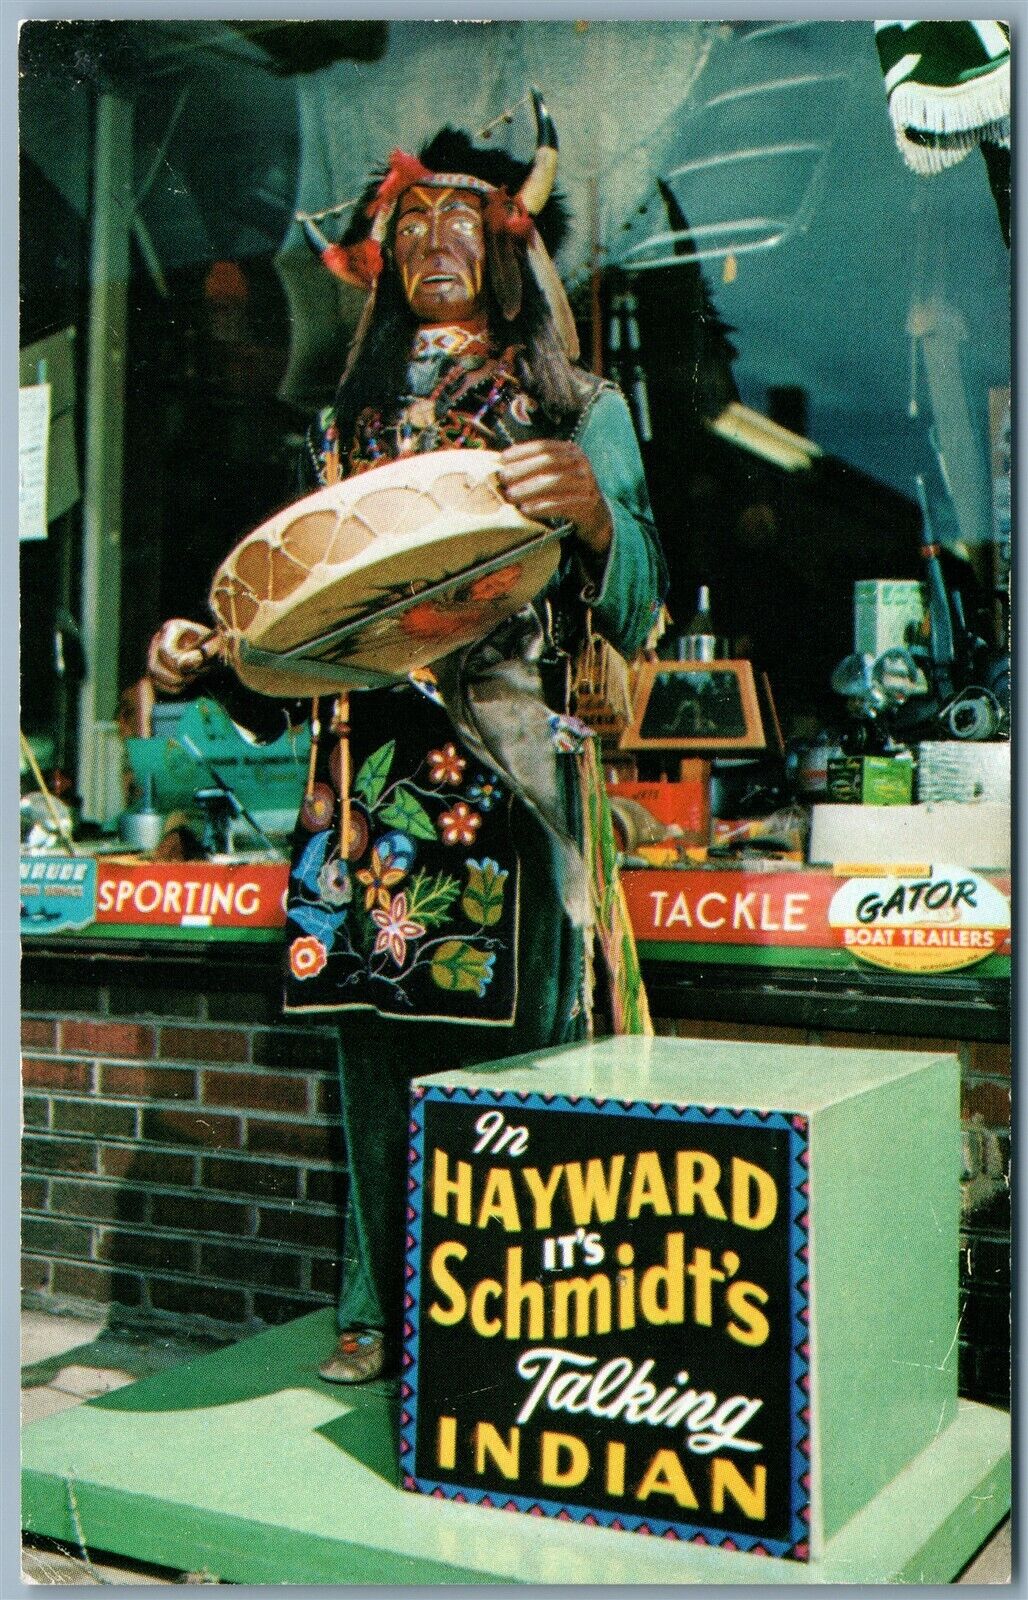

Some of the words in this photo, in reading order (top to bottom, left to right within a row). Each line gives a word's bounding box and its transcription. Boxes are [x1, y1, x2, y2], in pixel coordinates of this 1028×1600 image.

[99, 880, 260, 915] SPORTING
[651, 891, 810, 932] TACKLE
[856, 878, 978, 924] GATOR
[844, 928, 895, 946] BOAT
[902, 929, 996, 948] TRAILERS
[473, 1111, 530, 1157] In
[432, 1147, 779, 1232] HAYWARD
[542, 1228, 605, 1270] IT'S
[429, 1232, 771, 1347] Schmidt's
[517, 1347, 764, 1455] Talking
[438, 1415, 767, 1521] INDIAN
